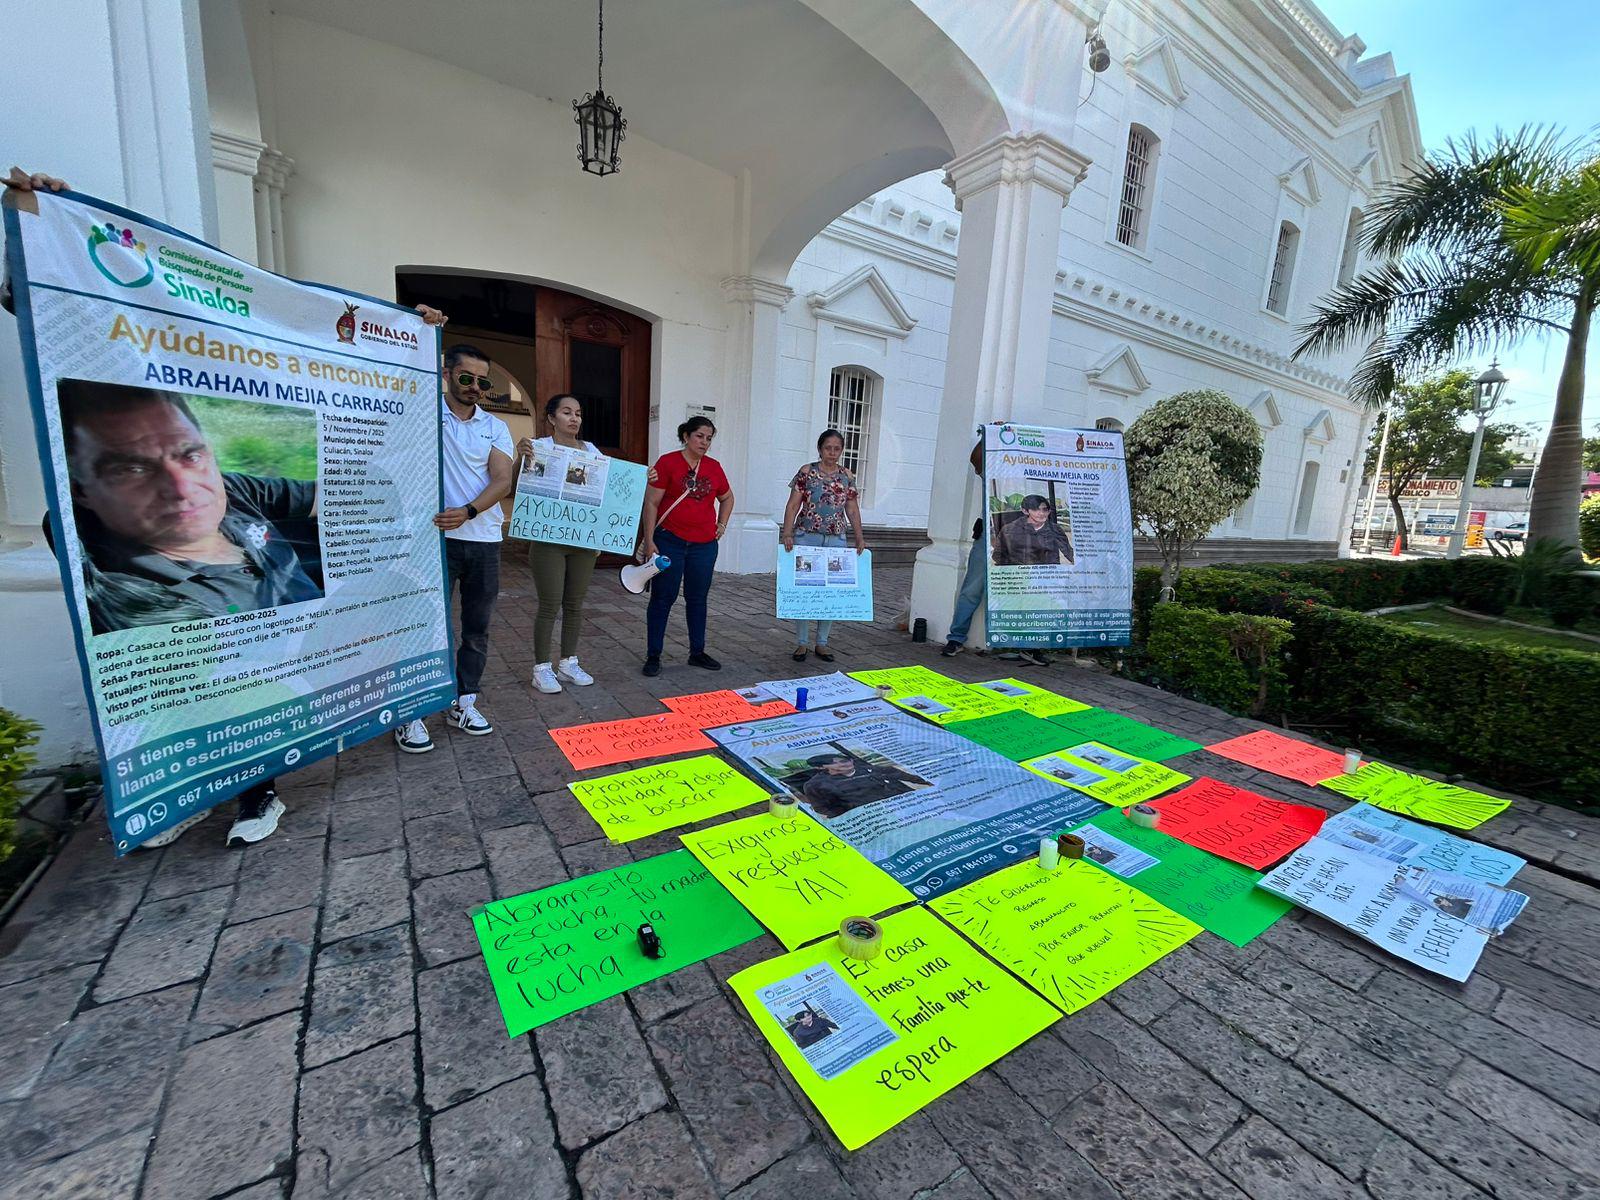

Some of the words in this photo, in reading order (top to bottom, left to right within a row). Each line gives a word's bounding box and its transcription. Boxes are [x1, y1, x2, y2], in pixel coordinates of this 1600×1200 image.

[158, 245, 203, 267] Comisión
[204, 260, 233, 276] Estatal
[233, 270, 244, 280] de
[158, 256, 204, 279] Búsqueda
[204, 272, 216, 282] de
[216, 275, 254, 293] Personas
[163, 272, 251, 318] Sinaloa
[360, 321, 418, 344] SINALOA
[108, 313, 279, 371] Ayúdanos
[287, 354, 301, 375] a
[308, 359, 406, 393] encontrar
[408, 379, 418, 396] a
[145, 362, 269, 399] ABRAHAM
[276, 381, 329, 406] MEJIA
[331, 391, 405, 416] CARRASCO
[322, 413, 342, 422] Fecha
[343, 415, 352, 423] de
[333, 425, 368, 436] Noviembre
[323, 435, 356, 445] Municipio
[357, 437, 367, 446] del
[354, 448, 374, 456] Sinaloa
[1017, 436, 1045, 448] Sinaloa
[1086, 439, 1114, 447] SINALOA
[324, 457, 342, 465] Sexo:
[324, 468, 342, 476] Edad:
[343, 468, 352, 476] 49
[1003, 453, 1053, 466] Ayúdanos
[1062, 459, 1109, 470] encontrar
[1023, 468, 1059, 479] ABRAHAM
[1060, 471, 1083, 480] MEJIA
[1083, 473, 1100, 481] RIOS
[338, 489, 363, 497] Moreno
[323, 509, 341, 517] Cara:
[323, 519, 341, 528] Ojos:
[514, 495, 598, 524] AYUDALOS
[608, 512, 634, 528] QUE
[324, 530, 344, 538] Nariz:
[325, 539, 352, 548] Cabello:
[511, 517, 582, 541] REGRESEN
[586, 529, 596, 545] A
[602, 532, 634, 549] CASA
[327, 560, 346, 569] Boca:
[328, 570, 348, 579] Cejas:
[171, 621, 212, 634] Cedula:
[214, 609, 278, 628] RZC-0900-2025
[991, 612, 998, 620] Si
[96, 646, 125, 662] Ropa:
[127, 640, 166, 653] Casaca
[186, 633, 212, 645] color
[215, 628, 244, 639] oscuro
[98, 660, 133, 674] cadena
[152, 650, 184, 662] acero
[186, 639, 236, 657] inoxidable
[101, 673, 129, 688] Señas
[130, 660, 200, 680] Particulares:
[103, 681, 148, 701] Tatuajes:
[149, 672, 199, 689] Ninguno.
[105, 700, 129, 715] Visto
[150, 683, 186, 700] última
[117, 759, 133, 777] Si
[140, 736, 197, 766] tienes
[206, 703, 304, 744] información
[309, 683, 361, 710] referente
[375, 670, 396, 685] esta
[400, 656, 445, 676] persona,
[120, 768, 166, 798] llama
[170, 761, 182, 774] o
[186, 728, 286, 768] escribenos.
[289, 718, 307, 731] Tu
[310, 703, 346, 725] ayuda
[363, 689, 385, 706] muy
[387, 668, 446, 694] importante.
[571, 745, 603, 759] del
[177, 787, 202, 808] 667
[206, 763, 266, 794] 1841256
[574, 769, 679, 796] Prohibido
[591, 784, 667, 810] olvidar
[675, 780, 689, 794] y
[692, 766, 738, 789] dejar
[606, 811, 637, 827] de
[649, 788, 719, 818] buscar
[984, 829, 1000, 838] Tu
[1183, 819, 1253, 850] TODOS
[1240, 799, 1292, 828] FALTA
[696, 819, 813, 864] Exigimos
[1229, 823, 1314, 865] ABRAHAM
[728, 836, 848, 889] respuestas
[881, 861, 895, 872] Si
[896, 844, 930, 863] tienes
[1265, 873, 1291, 892] UNA
[1279, 866, 1305, 882] VEZ
[1292, 852, 1317, 874] MAS
[1316, 856, 1350, 880] HAGAN
[945, 866, 962, 879] 667
[1303, 877, 1329, 894] QUE
[483, 870, 643, 931] Abramsito
[776, 870, 854, 906] YA!
[973, 892, 1000, 913] TE
[1000, 875, 1051, 903] QUEREMOS
[1291, 888, 1316, 905] LAS
[493, 904, 617, 951] escucha,
[627, 887, 657, 905] tu
[660, 868, 712, 894] madre
[1370, 899, 1391, 909] A
[506, 942, 576, 975] esta
[593, 921, 636, 941] en
[639, 908, 667, 925] la
[1061, 922, 1089, 942] FAVOR
[884, 934, 930, 964] Casa
[516, 955, 624, 1009] lucha
[863, 975, 915, 1003] tienes
[916, 954, 951, 980] una
[890, 998, 947, 1035] Familia
[875, 1034, 958, 1092] espera
